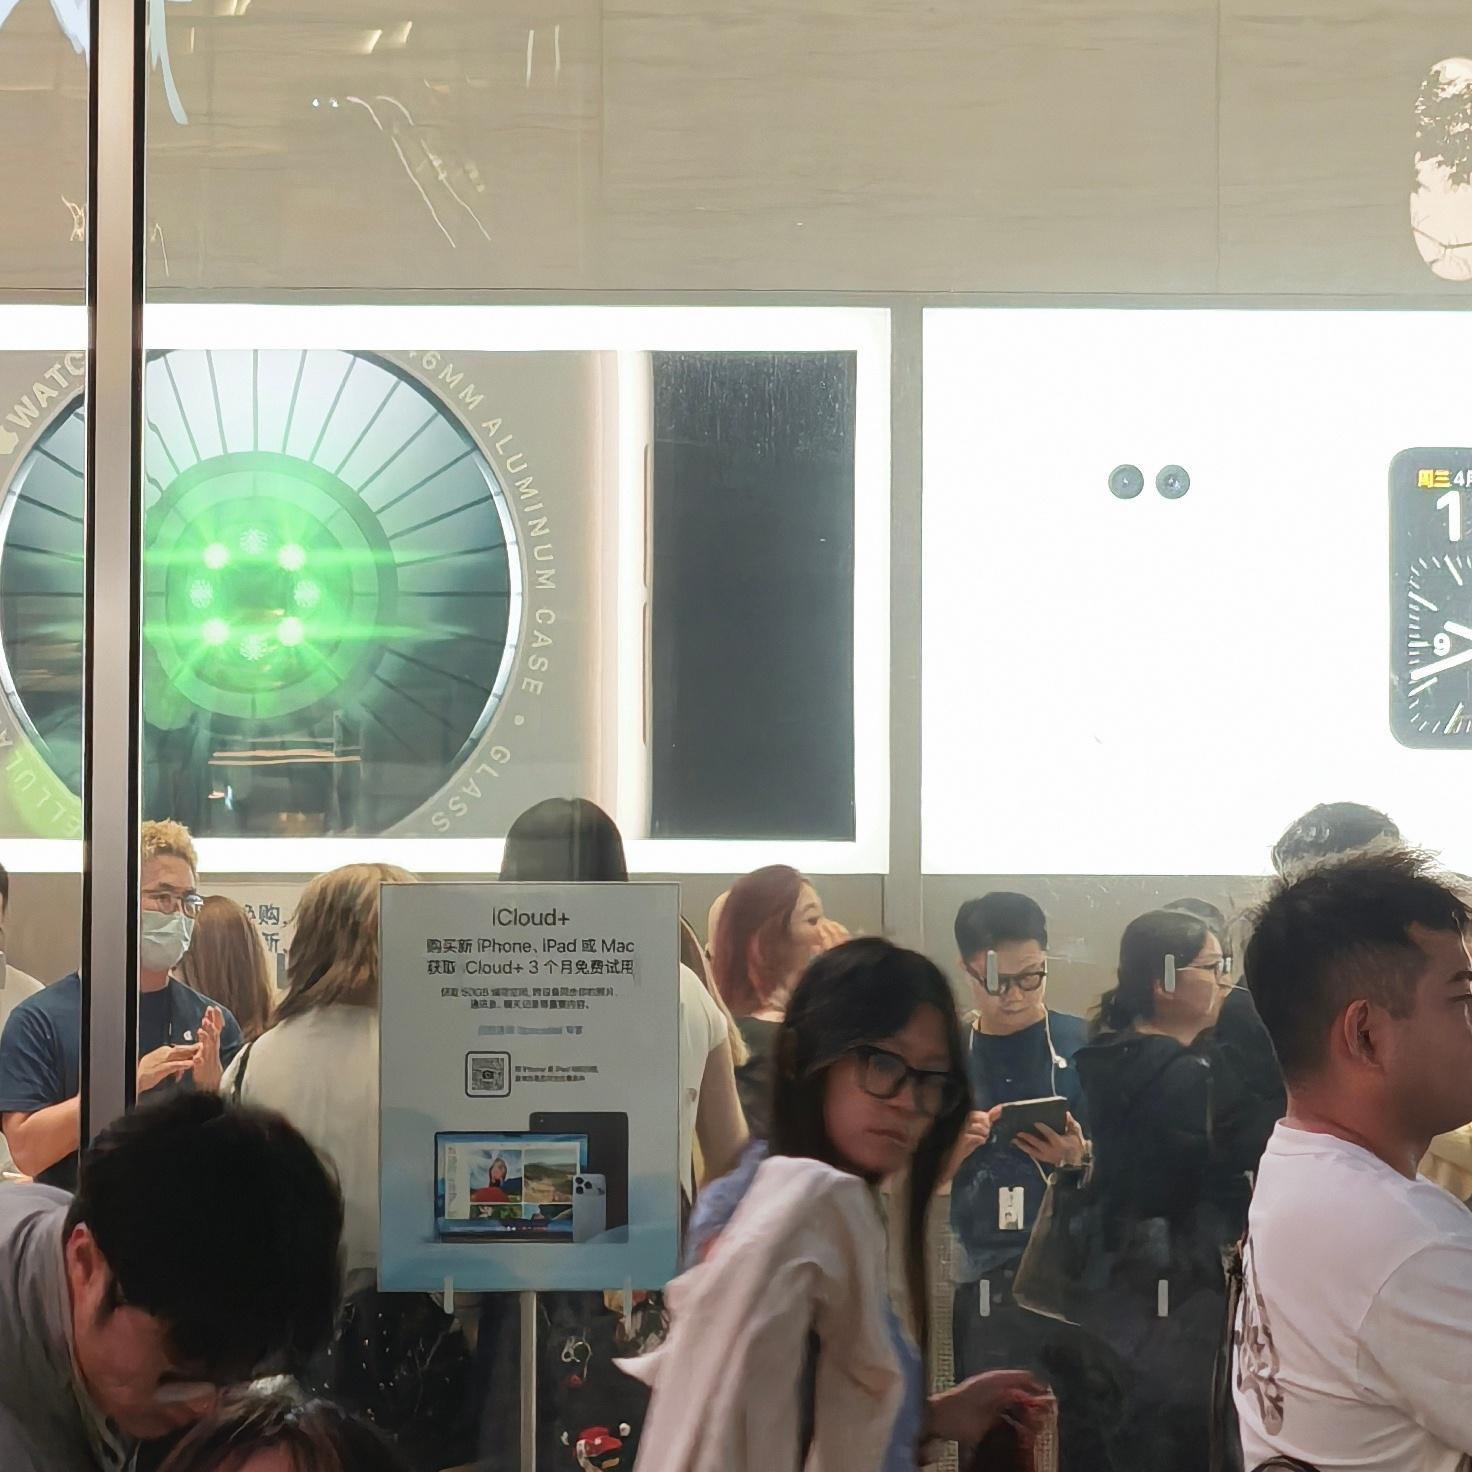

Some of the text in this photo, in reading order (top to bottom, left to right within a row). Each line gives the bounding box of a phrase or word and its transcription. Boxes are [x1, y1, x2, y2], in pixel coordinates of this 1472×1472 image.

[5, 352, 86, 429] WATC
[1436, 490, 1461, 542] 1
[409, 350, 557, 834] 6MM ALUMINUM CASE GLASS
[1433, 632, 1451, 657] 9
[426, 939, 473, 955] 购买新
[601, 939, 635, 954] Mac
[528, 960, 539, 974] 3
[544, 959, 635, 975] 个月免费试用
